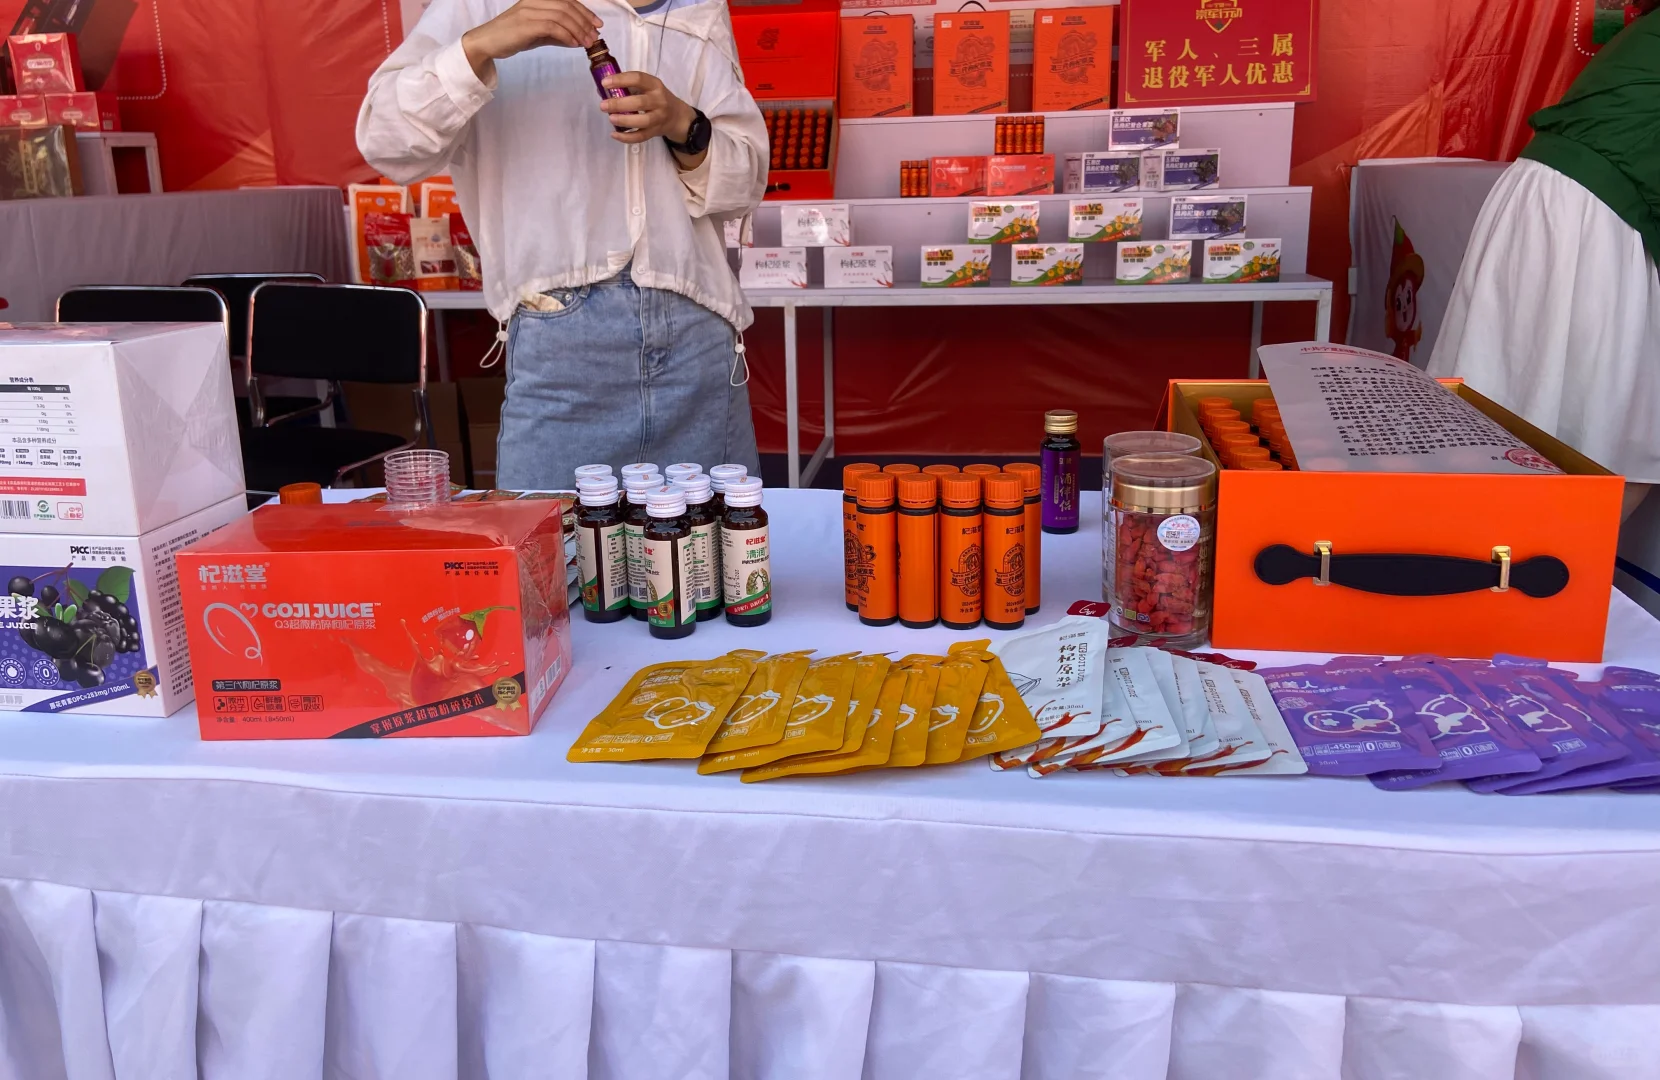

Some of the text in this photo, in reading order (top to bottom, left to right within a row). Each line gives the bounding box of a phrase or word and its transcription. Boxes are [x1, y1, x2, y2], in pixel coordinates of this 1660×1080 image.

[1144, 33, 1294, 62] 军人、三属
[1142, 61, 1294, 88] 退役军人优惠
[755, 260, 790, 270] 枸杞原浆
[840, 259, 876, 268] 枸杞原浆
[746, 536, 766, 545] 杞滋堂
[70, 546, 90, 554] PICC
[746, 548, 766, 559] 清润
[198, 564, 267, 583] 杞滋堂
[0, 596, 40, 620] 果浆
[262, 603, 310, 618] GOJI
[274, 620, 376, 630] Q3超微粉碎枸杞原浆
[1056, 644, 1076, 687] 枸杞原浆
[216, 681, 278, 690] 第三代枸杞原浆
[370, 692, 485, 735] 掌握原浆超微粉碎技术
